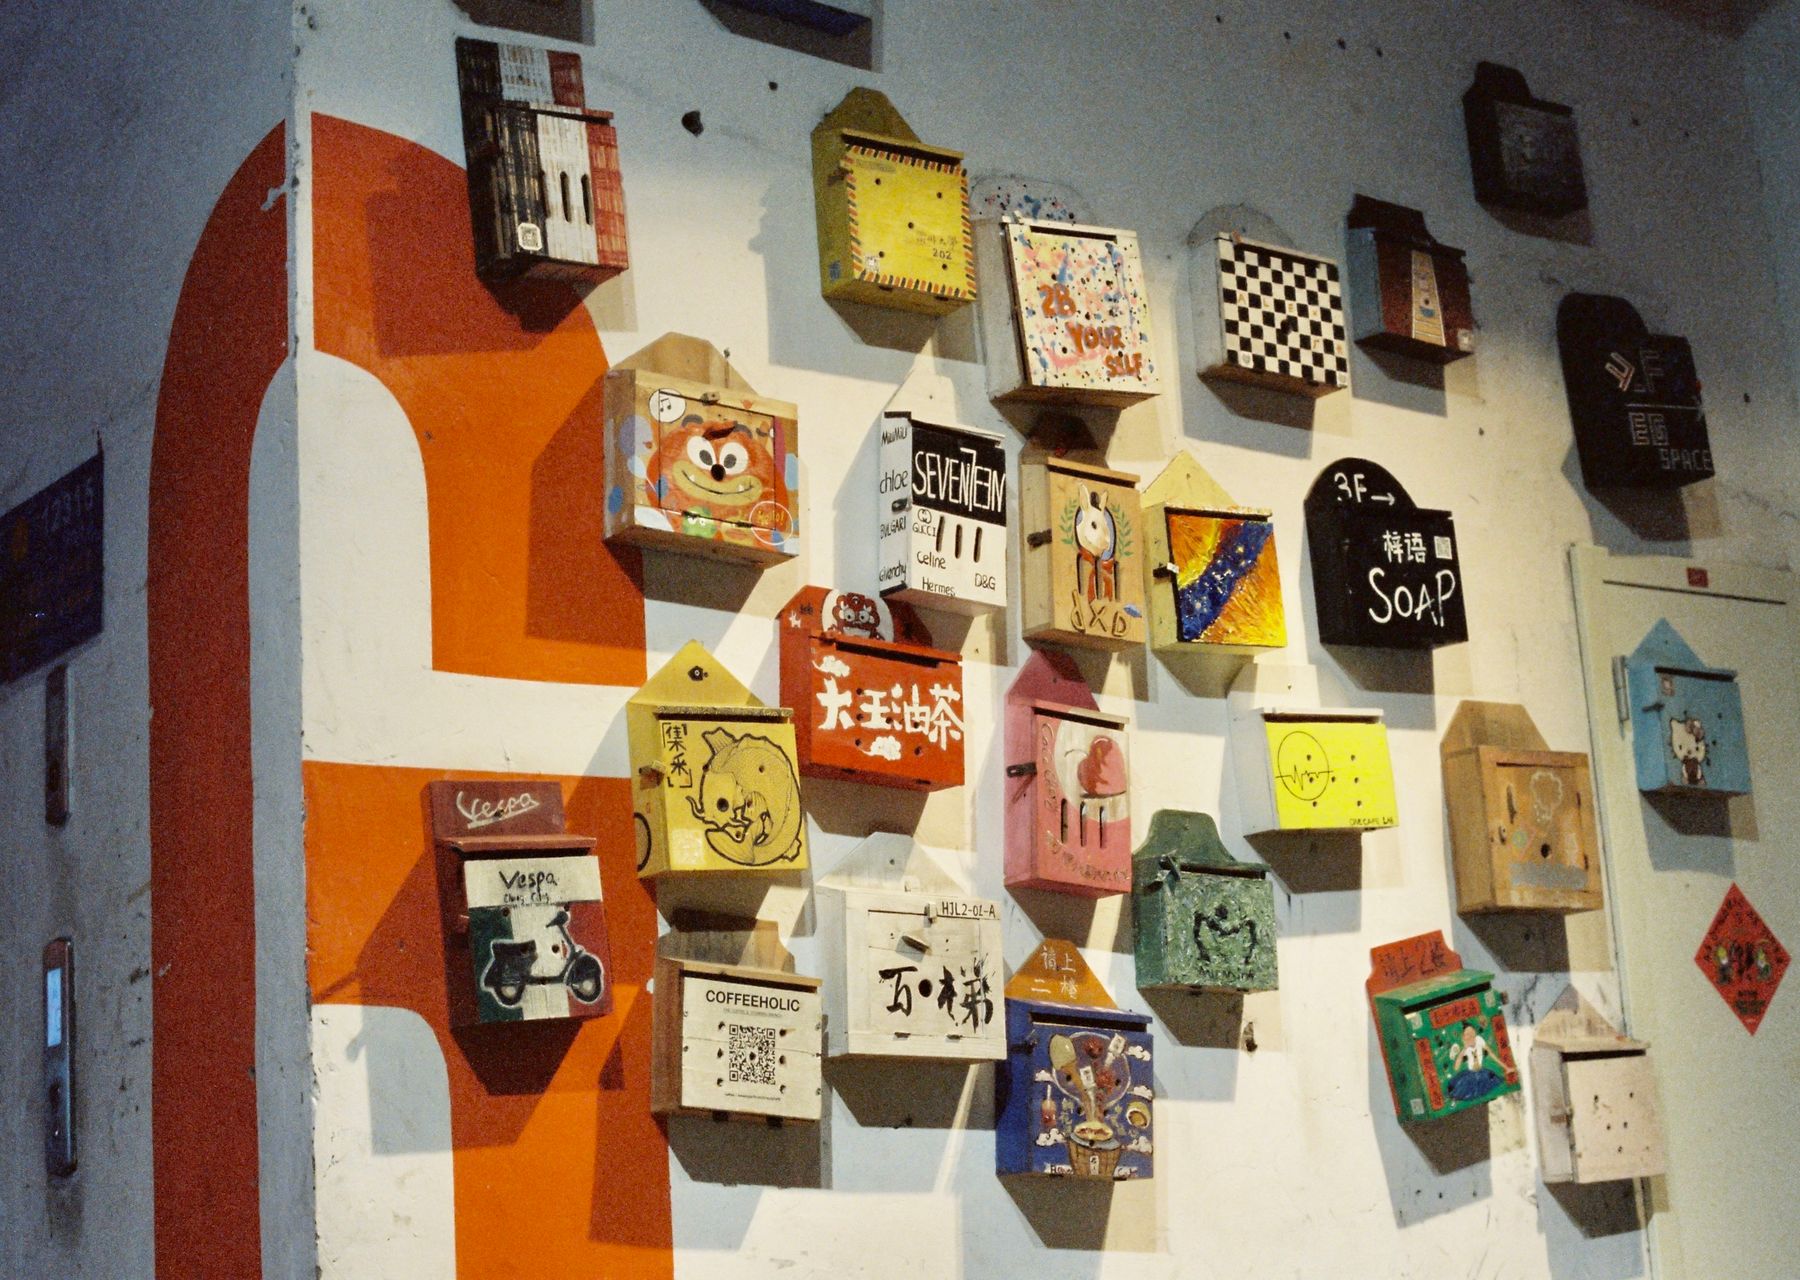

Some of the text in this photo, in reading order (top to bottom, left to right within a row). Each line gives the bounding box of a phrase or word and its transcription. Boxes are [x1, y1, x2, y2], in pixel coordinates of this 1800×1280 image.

[932, 247, 953, 261] 202
[1065, 321, 1125, 356] YOUR
[1659, 449, 1713, 470] SPACE
[912, 523, 937, 538] GUCCI
[916, 550, 947, 570] Celine
[974, 573, 996, 591] D&G
[499, 870, 558, 901] Vespa
[705, 989, 801, 1012] COFFEEHOLIC
